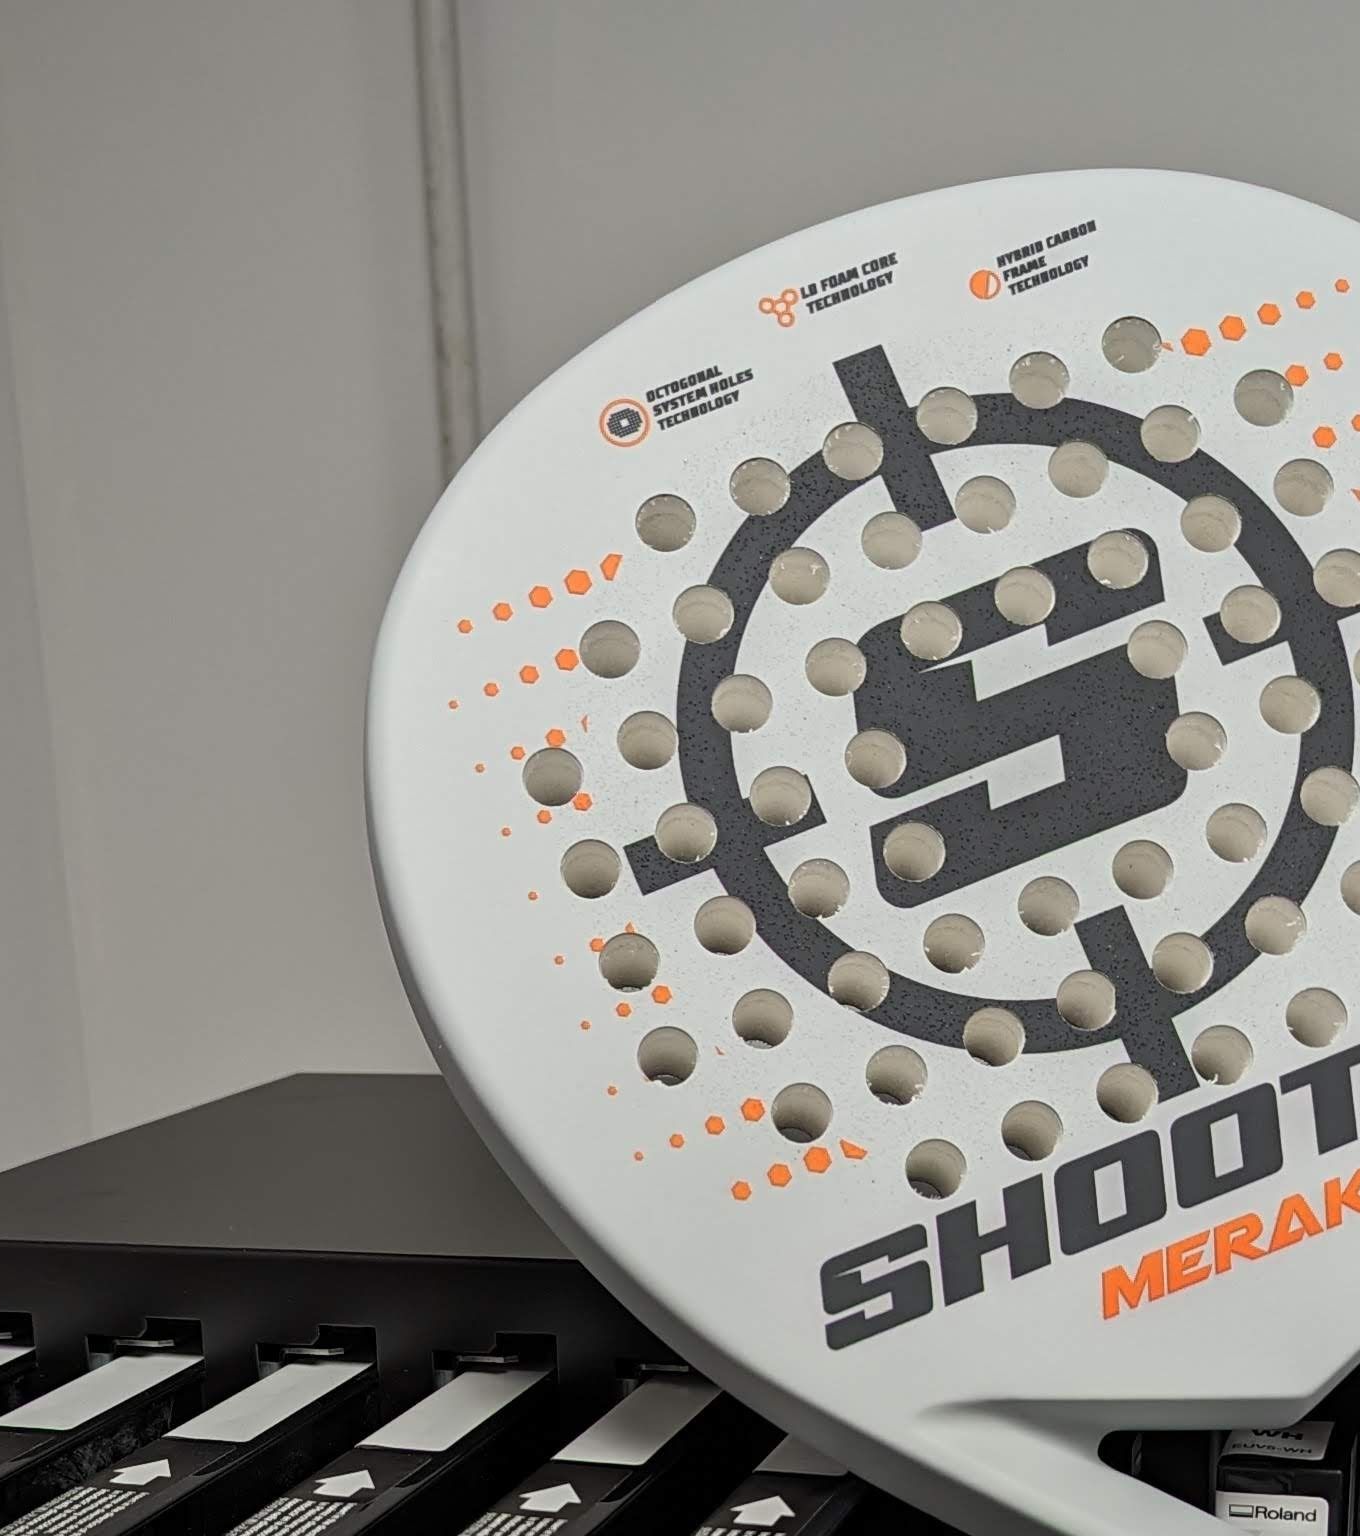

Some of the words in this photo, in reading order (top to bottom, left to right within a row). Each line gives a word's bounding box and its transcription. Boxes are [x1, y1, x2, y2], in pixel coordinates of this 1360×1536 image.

[996, 240, 1044, 269] HYBRID
[1045, 219, 1097, 249] CARBON
[820, 266, 860, 292] FOAM
[861, 252, 898, 276] CORE
[1002, 255, 1048, 282] FRAME
[1008, 254, 1089, 296] TECHNOLOGY
[805, 270, 893, 314] TECHNOLOGY
[646, 365, 723, 403] OCTOGONAL
[652, 386, 708, 417] SYSTEM
[709, 368, 754, 395] HOLES
[657, 389, 739, 431] TECHNOLOGY
[1255, 1505, 1317, 1522] Roland
